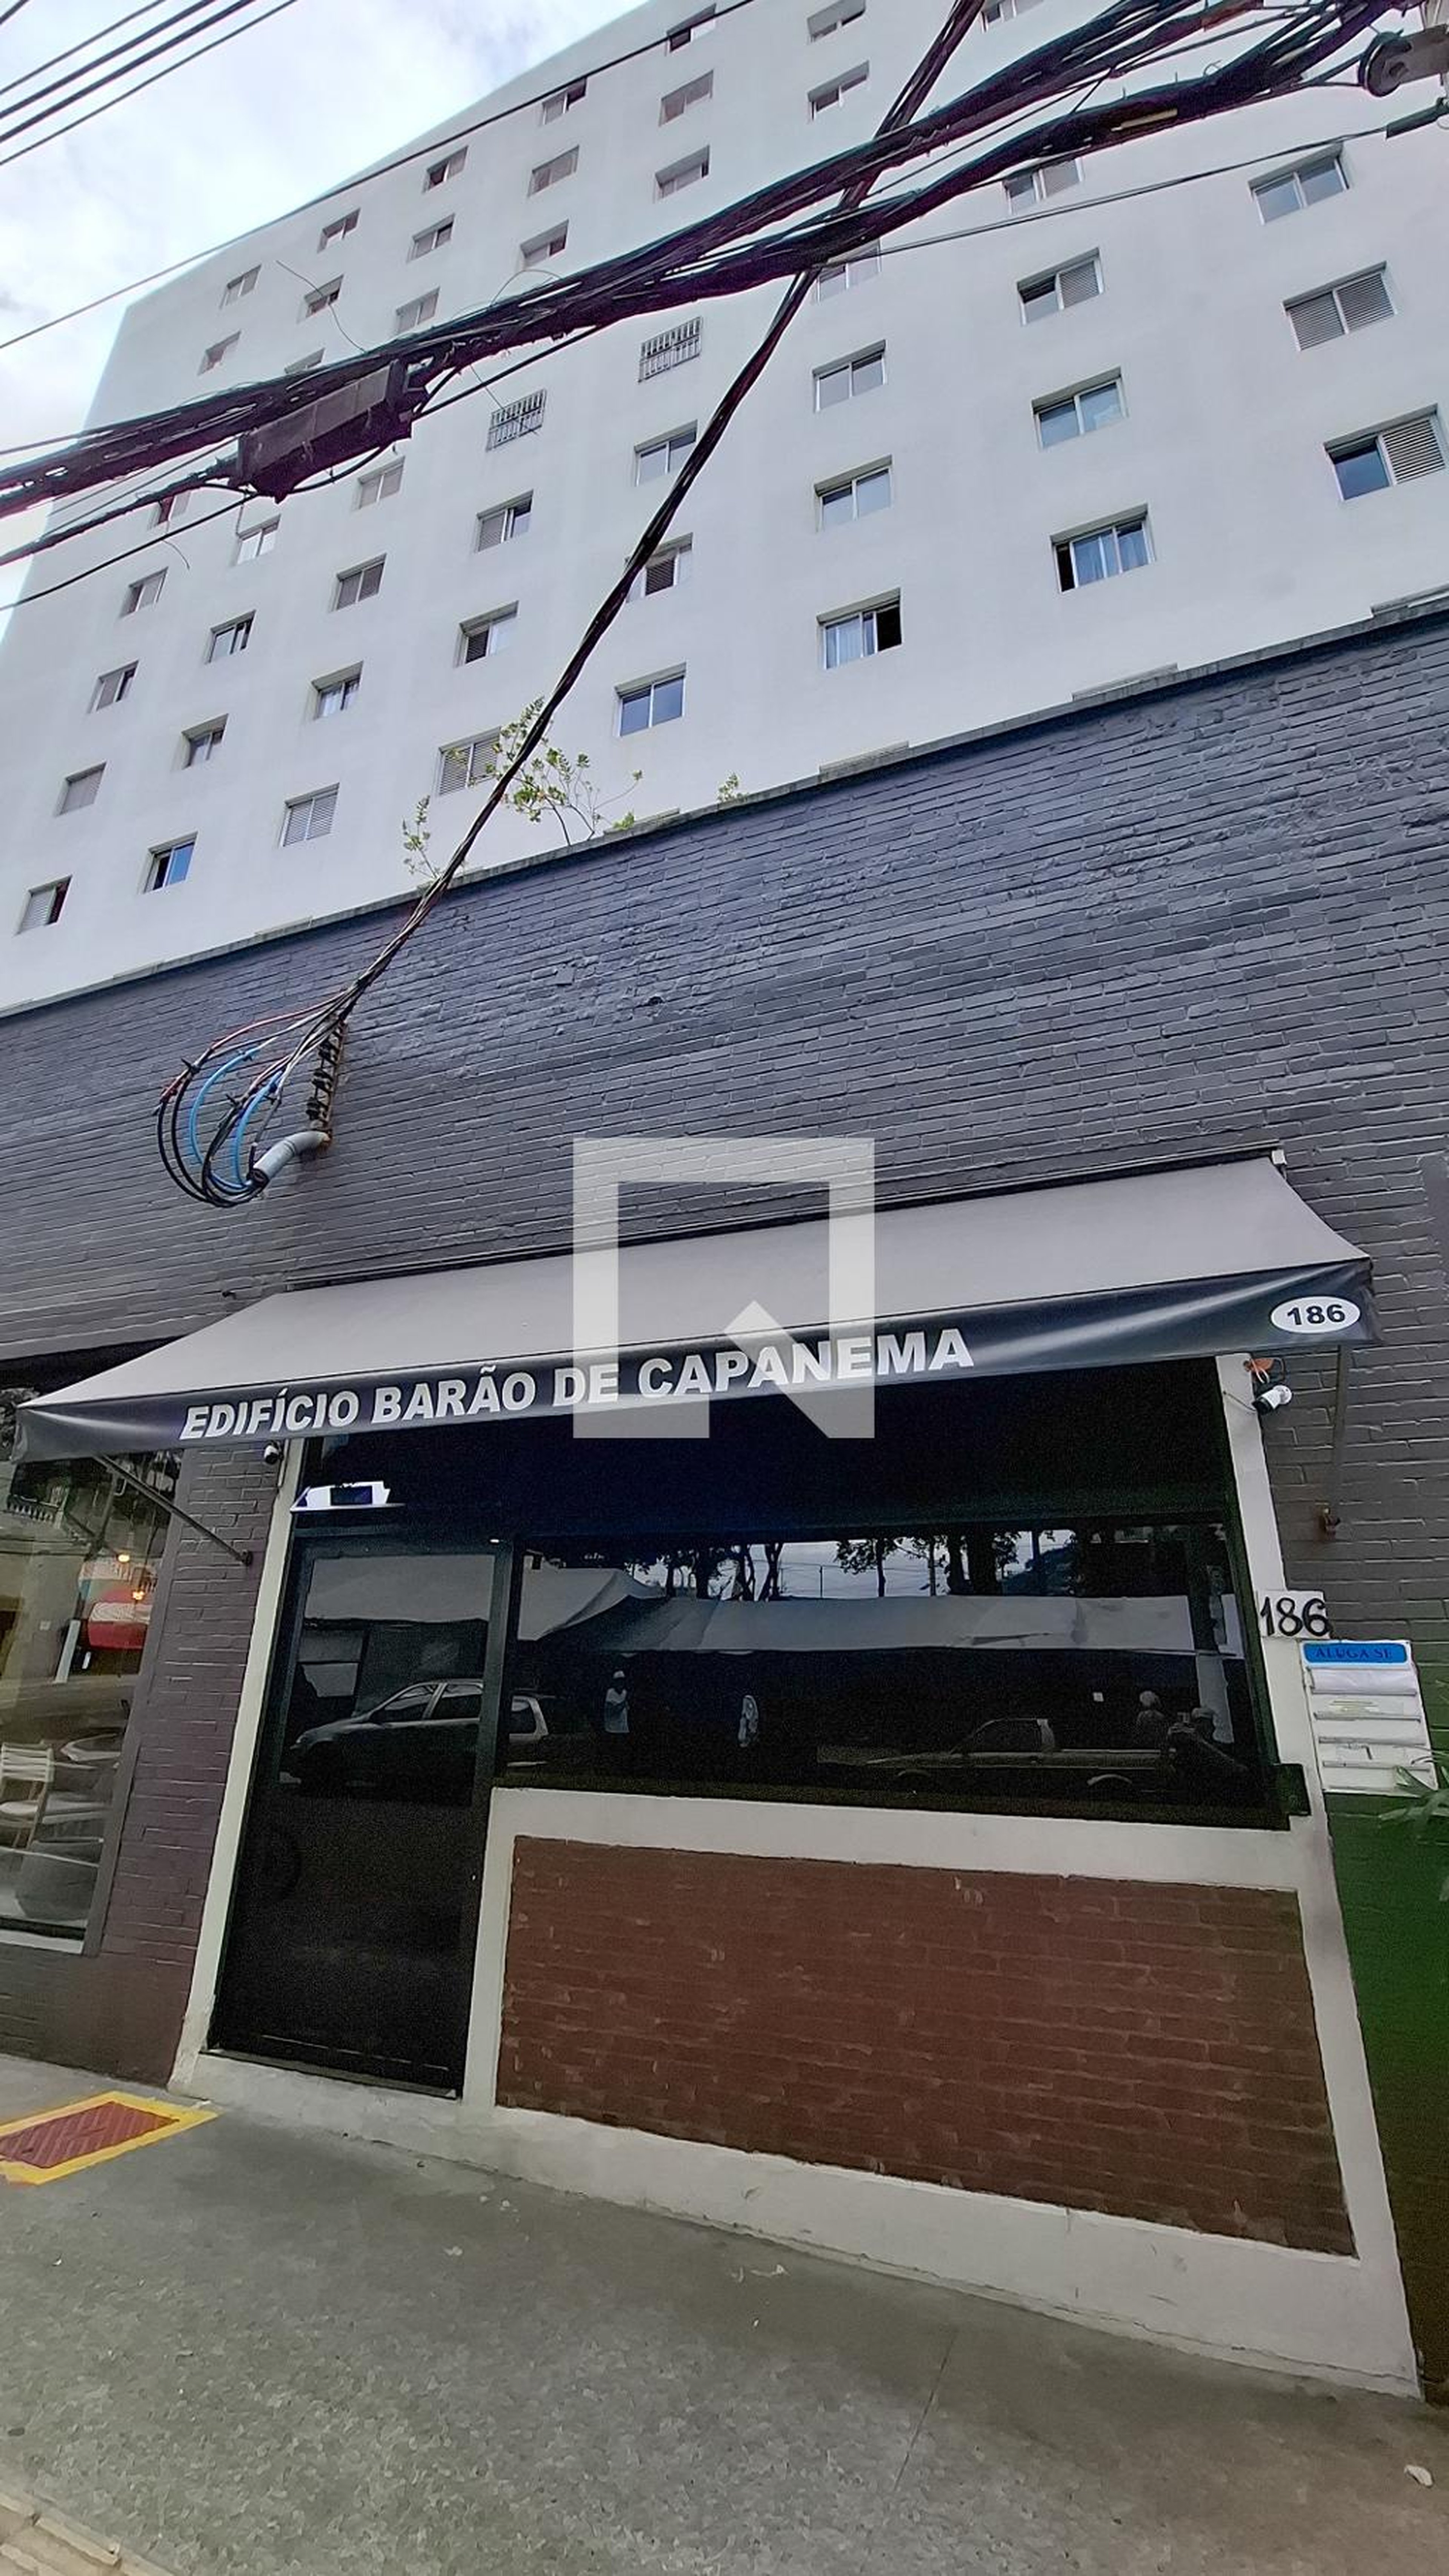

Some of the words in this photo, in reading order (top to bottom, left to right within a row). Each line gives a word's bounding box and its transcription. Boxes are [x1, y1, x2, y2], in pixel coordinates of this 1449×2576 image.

[1287, 1304, 1346, 1325] 186
[180, 1388, 359, 1440] EDIFÍCIO
[371, 1365, 535, 1424] BARÃO
[552, 1364, 619, 1407] DE
[638, 1328, 975, 1397] CAPANEMA
[1260, 1597, 1333, 1637] 186
